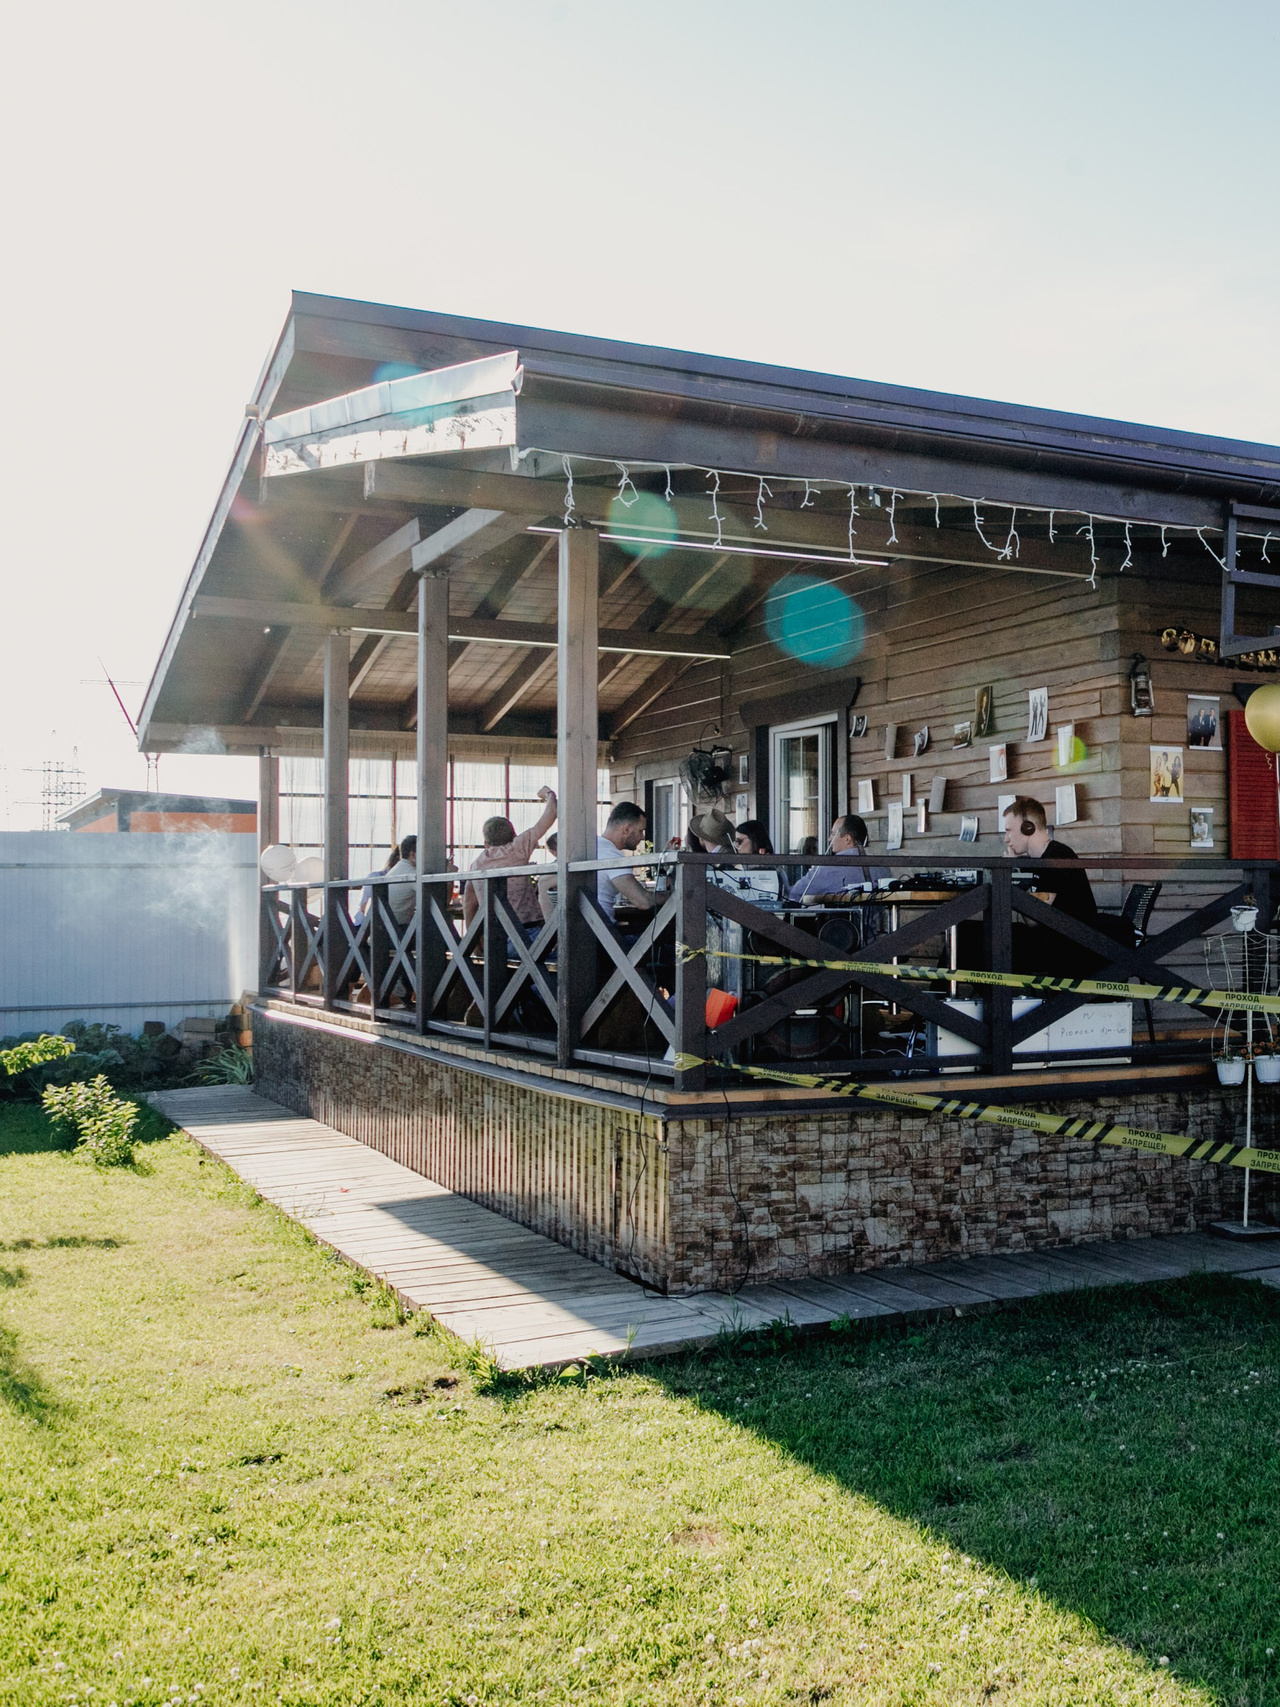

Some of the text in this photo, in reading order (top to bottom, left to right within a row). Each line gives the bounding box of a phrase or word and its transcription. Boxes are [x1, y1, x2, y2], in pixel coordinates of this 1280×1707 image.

[1096, 982, 1130, 993] ПРОХОД
[1225, 993, 1260, 1003] ПРОХОД
[1218, 1002, 1265, 1011] ЗАПРЕЩЕН
[997, 1114, 1041, 1129] ЗАПРЕЩЕН
[1128, 1128, 1162, 1141] ПРОХОД
[1121, 1137, 1167, 1151] ЗАПРЕЩЕН
